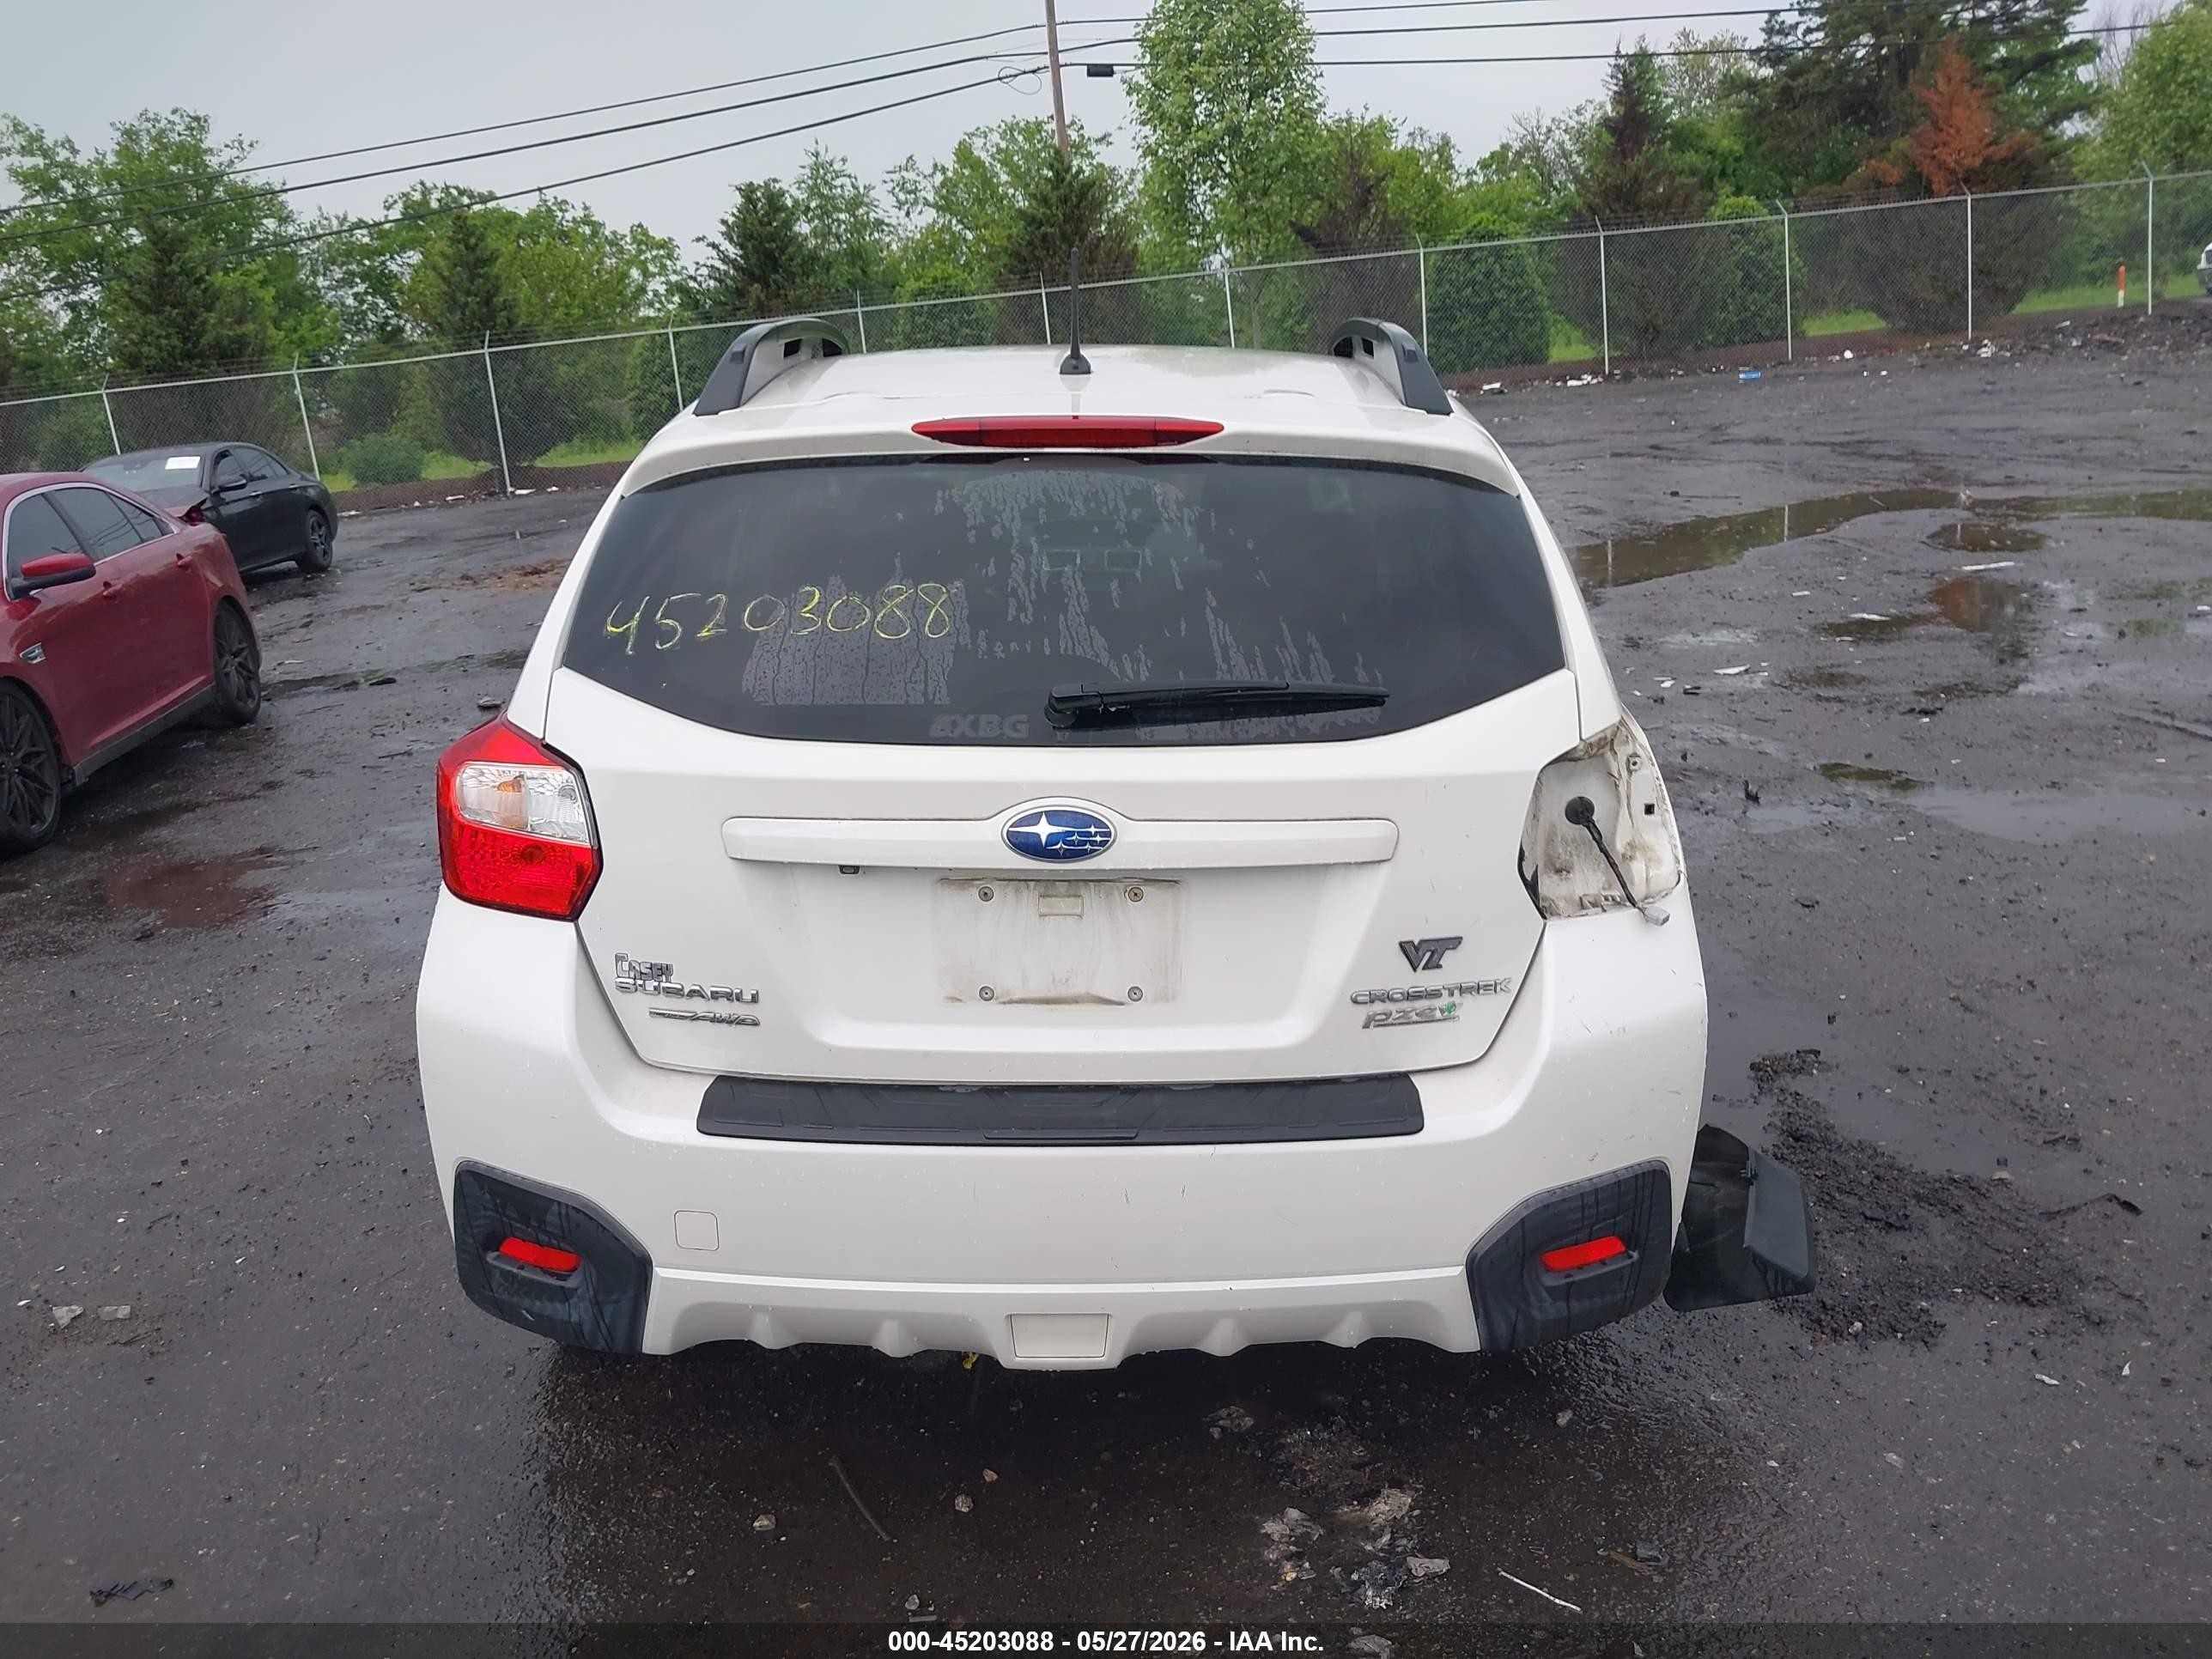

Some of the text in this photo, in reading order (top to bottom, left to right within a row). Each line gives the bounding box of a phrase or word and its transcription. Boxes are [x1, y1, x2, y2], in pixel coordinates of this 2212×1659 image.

[605, 584, 953, 654] 45203088
[1398, 936, 1463, 972] VT
[614, 977, 759, 1003] SUBARU
[1350, 977, 1511, 1005] CROSSTREK
[690, 1011, 760, 1026] AWD
